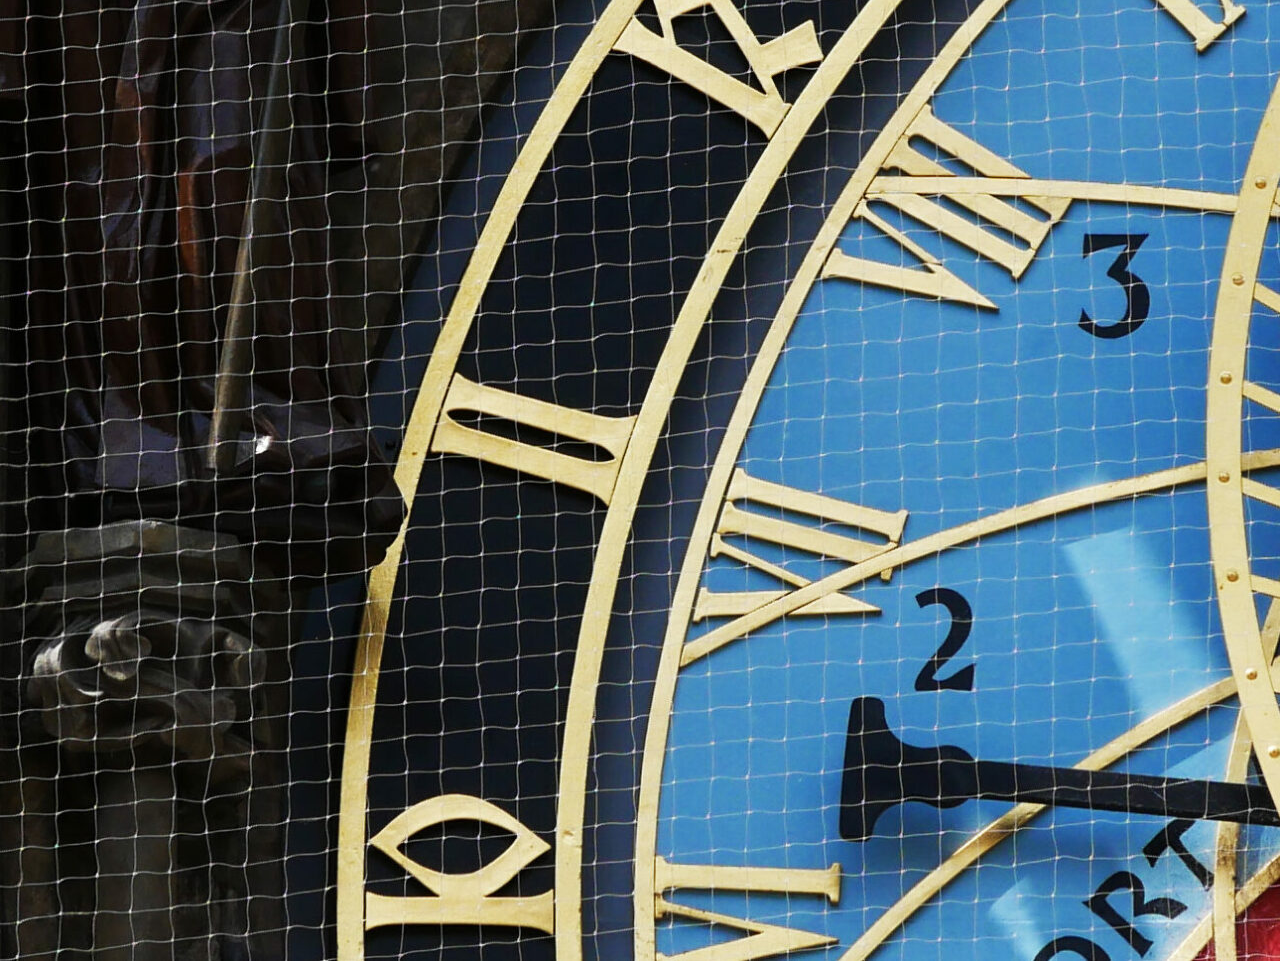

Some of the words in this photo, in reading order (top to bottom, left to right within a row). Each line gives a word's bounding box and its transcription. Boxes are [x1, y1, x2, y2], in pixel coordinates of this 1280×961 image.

[1078, 233, 1150, 338] 3
[692, 467, 909, 623] VII
[914, 587, 977, 692] 2
